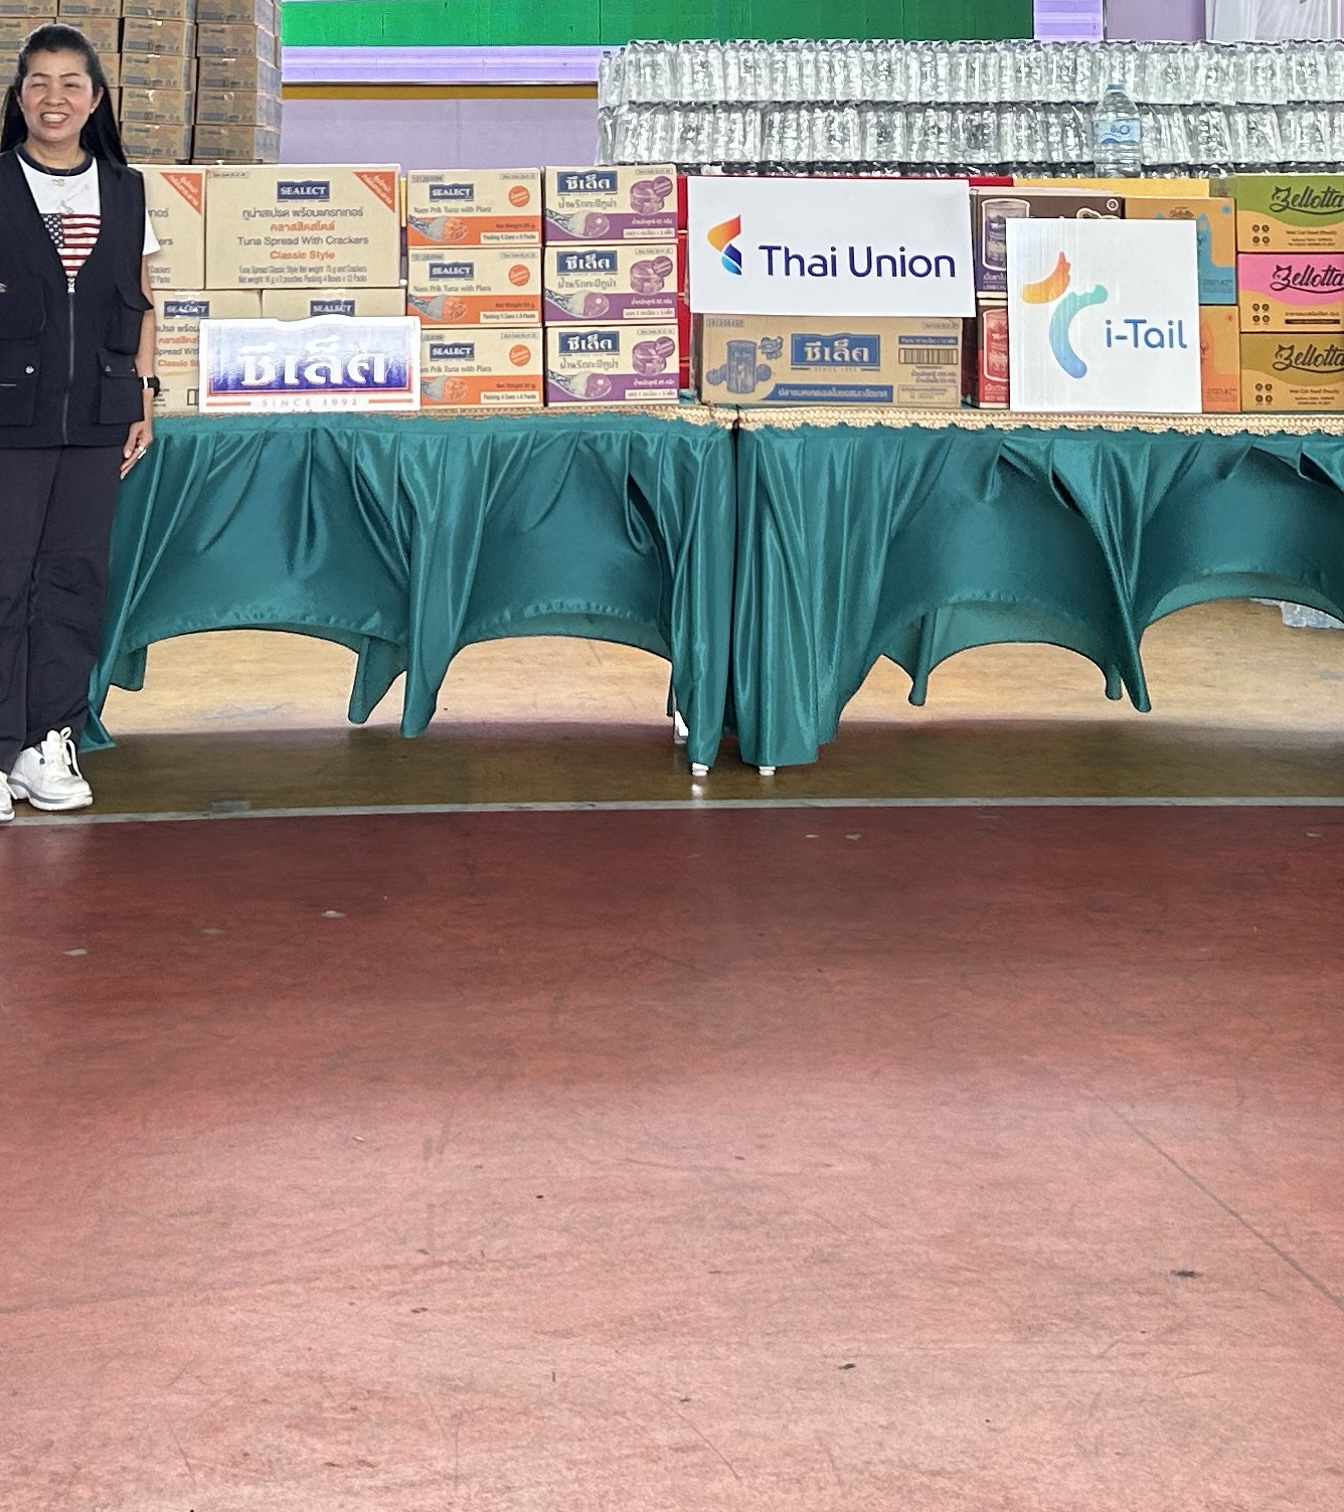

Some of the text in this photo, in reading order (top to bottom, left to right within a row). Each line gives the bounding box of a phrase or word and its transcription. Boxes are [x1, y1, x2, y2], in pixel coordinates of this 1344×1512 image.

[280, 186, 326, 195] SEALECT
[432, 189, 471, 197] SEALECT
[237, 235, 369, 247] Tuna Spread With Crackers
[270, 250, 335, 261] Classic Style
[758, 245, 956, 278] Thai Union
[432, 267, 471, 275] SEALECT
[313, 305, 351, 313] SEALECT
[1105, 318, 1188, 349] i-Tail
[261, 397, 358, 407] SINCE 1992
